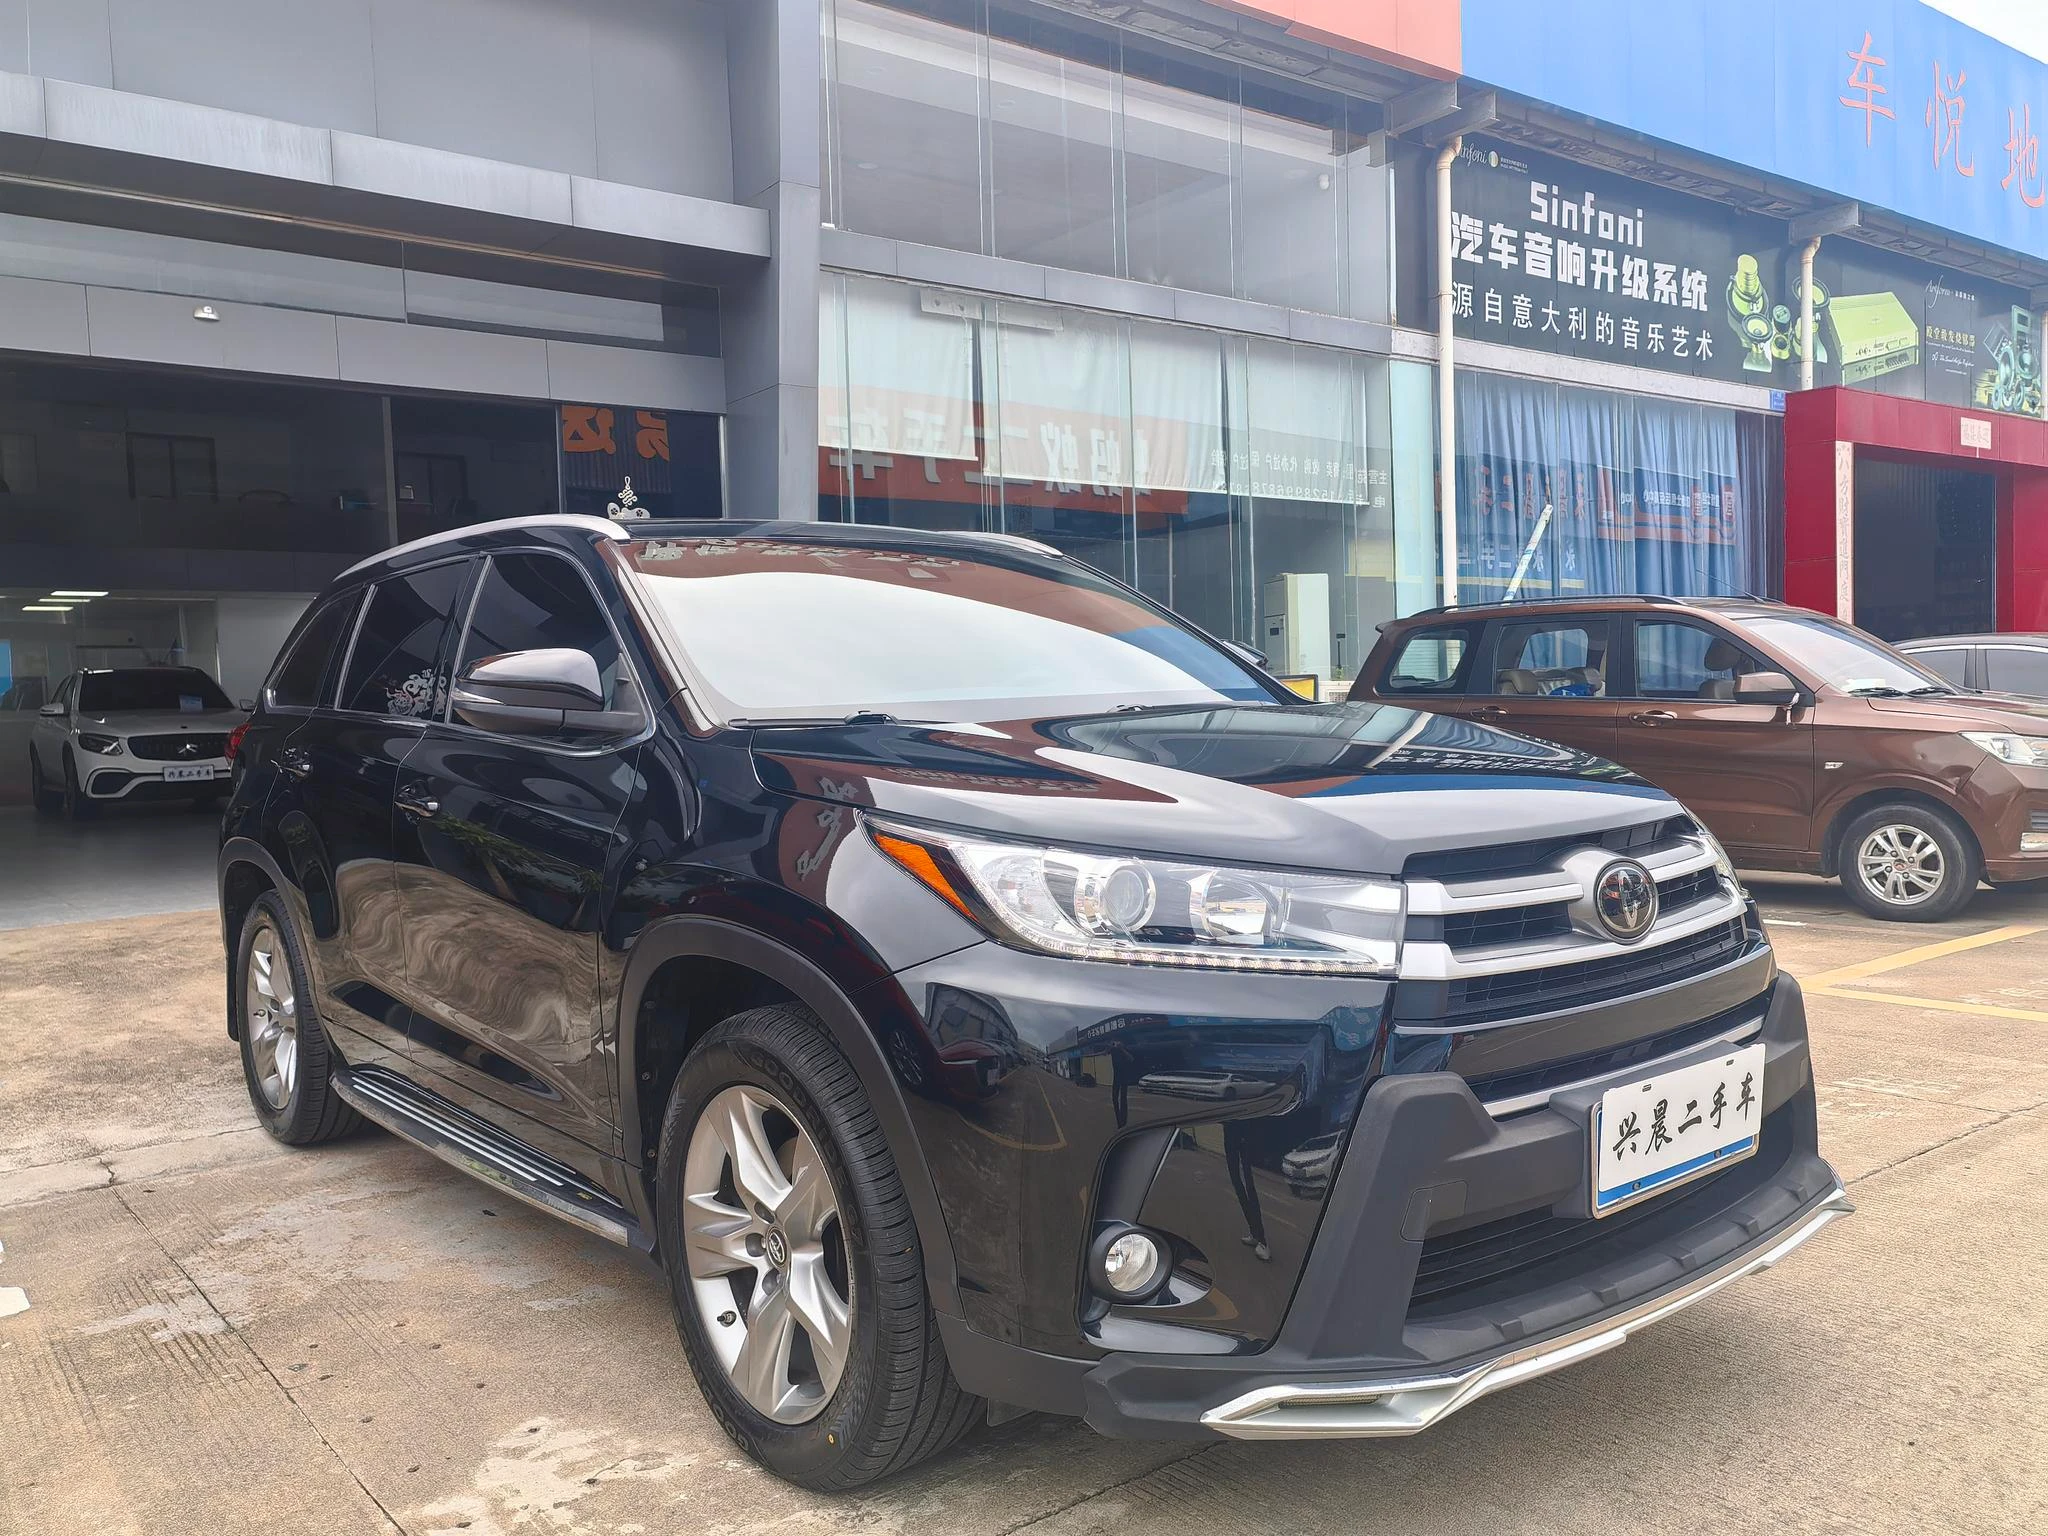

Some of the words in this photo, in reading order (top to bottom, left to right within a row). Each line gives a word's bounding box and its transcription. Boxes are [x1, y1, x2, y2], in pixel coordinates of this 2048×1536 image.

[1839, 31, 2046, 208] 车悦地
[1530, 180, 1644, 248] Sinfoni
[1451, 211, 1709, 312] 汽车音响升级系统
[1451, 281, 1714, 361] 源自意大利的音乐艺术
[1612, 1071, 1756, 1161] 兴晨二手车
